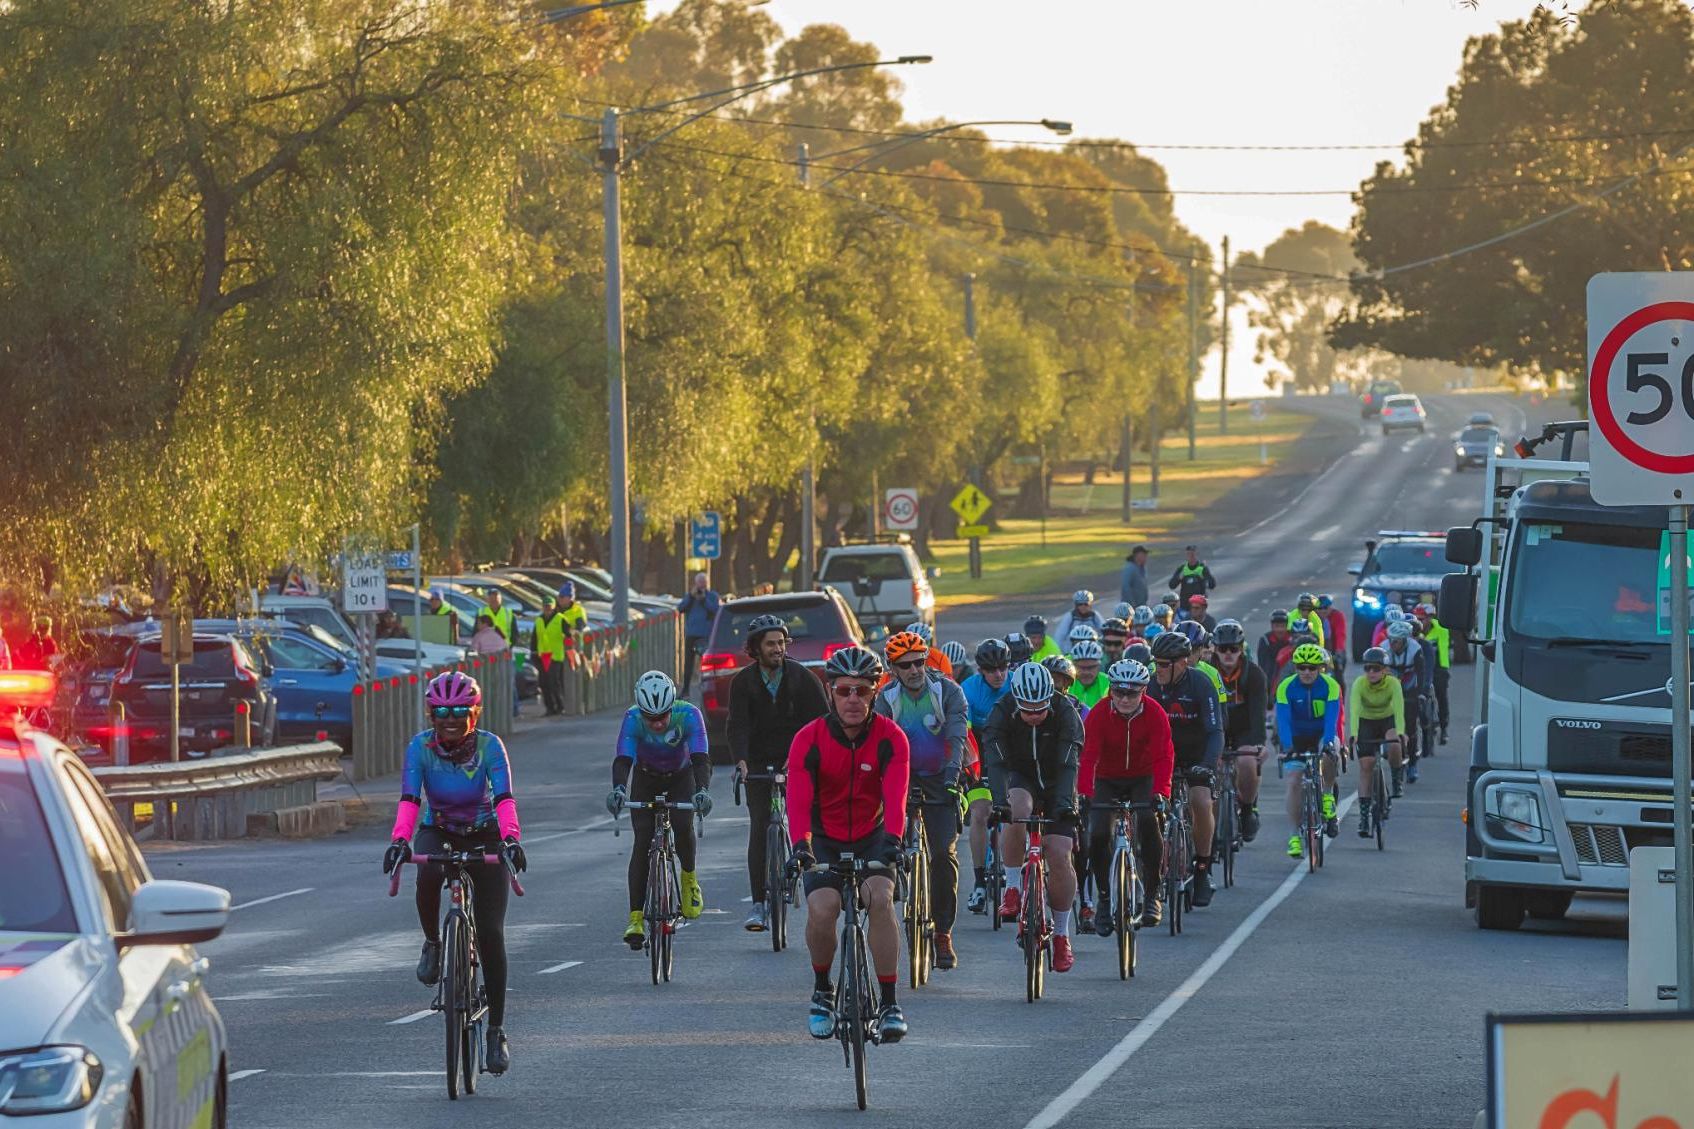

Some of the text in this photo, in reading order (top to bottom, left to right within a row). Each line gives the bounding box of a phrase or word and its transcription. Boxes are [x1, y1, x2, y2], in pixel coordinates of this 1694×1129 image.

[1626, 353, 1694, 425] 5
[893, 502, 909, 515] 60
[350, 576, 379, 588] LIMIT
[354, 594, 377, 606] 10 t
[1556, 719, 1602, 730] VOLVO
